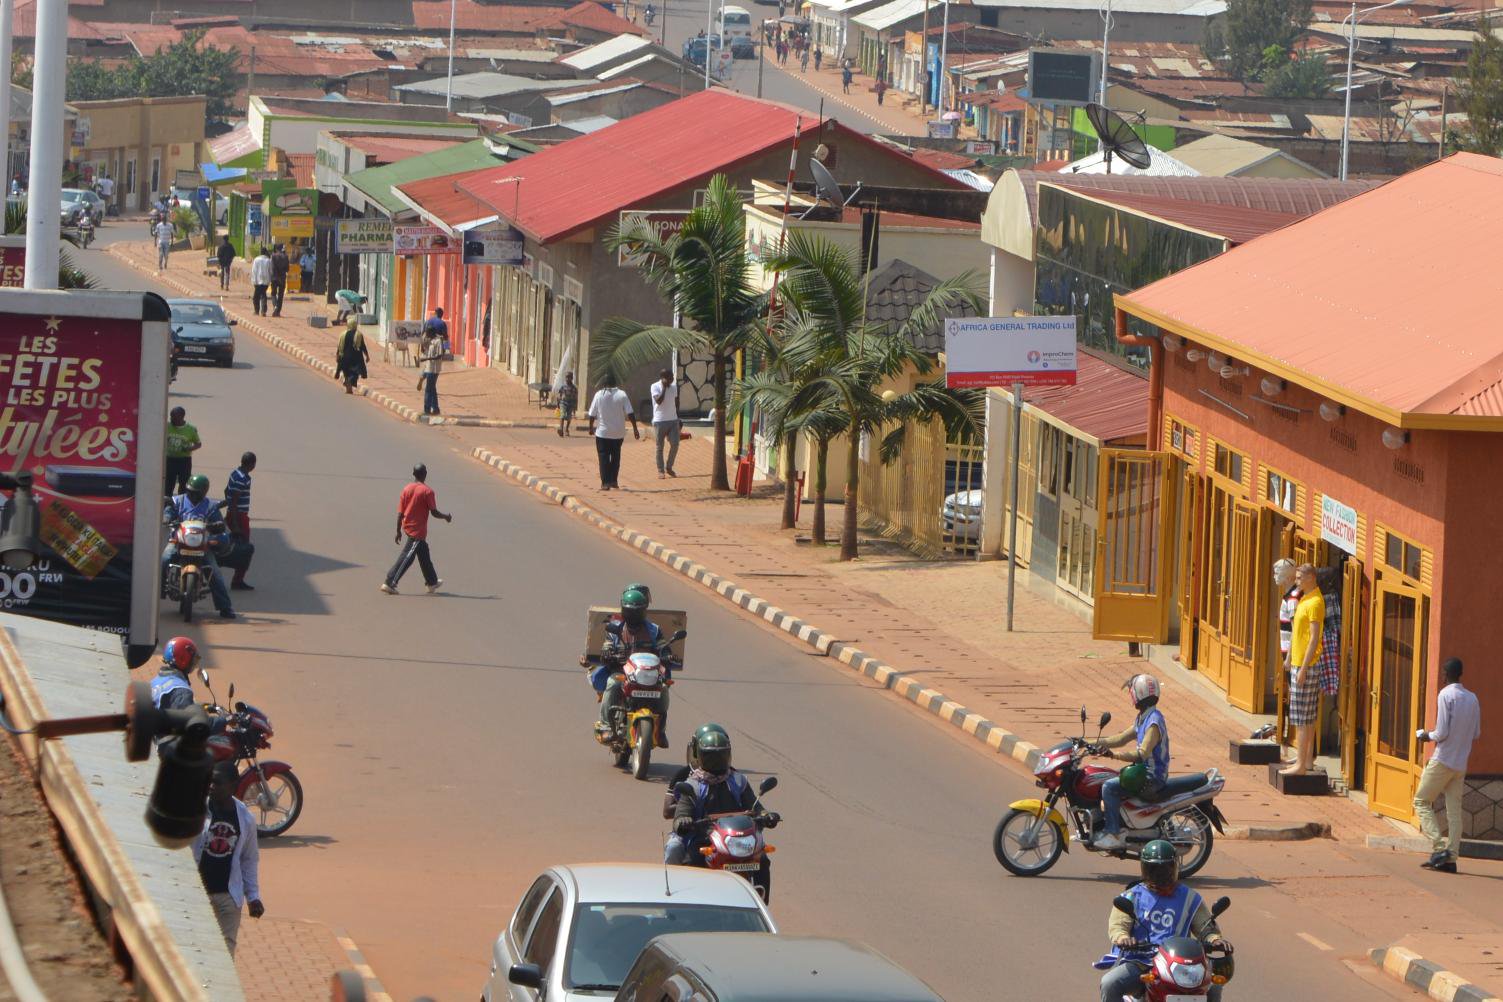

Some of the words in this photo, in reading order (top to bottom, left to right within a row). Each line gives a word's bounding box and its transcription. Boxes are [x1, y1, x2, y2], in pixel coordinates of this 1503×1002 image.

[341, 233, 394, 241] PHARMA
[960, 324, 987, 332] AFRICA
[990, 323, 1025, 331] GENERAL
[19, 336, 57, 353] LES
[7, 388, 45, 406] LES
[52, 391, 111, 409] PLUS
[0, 407, 134, 477] tylées
[1323, 513, 1355, 544] COLLECTION
